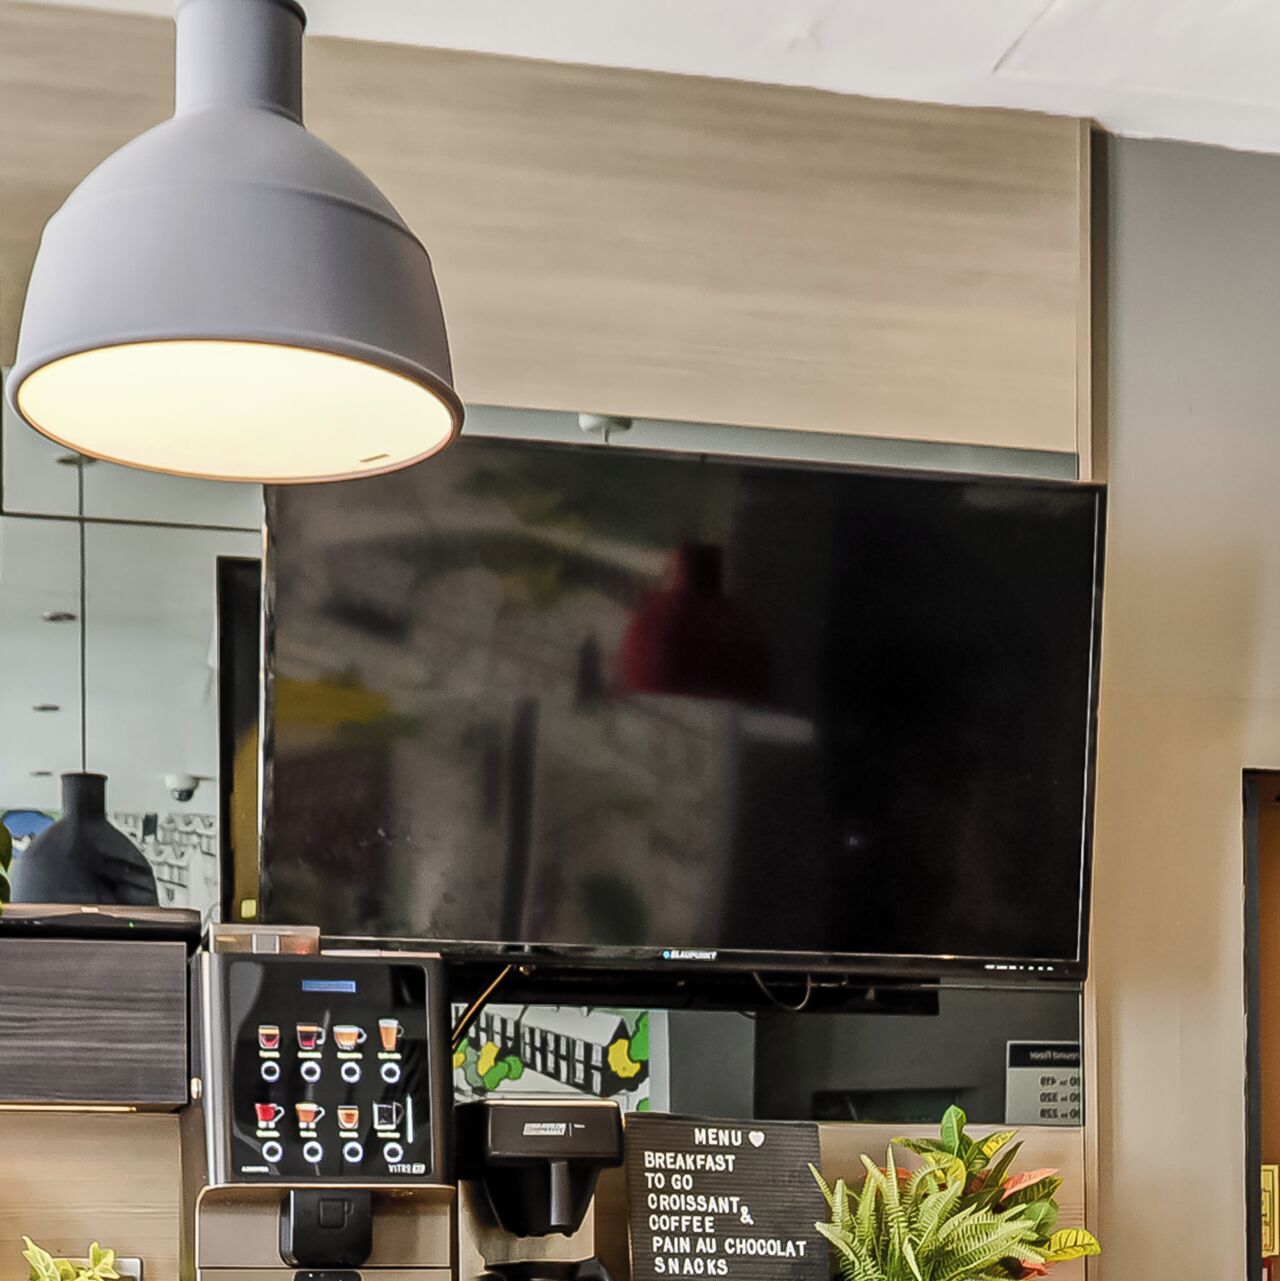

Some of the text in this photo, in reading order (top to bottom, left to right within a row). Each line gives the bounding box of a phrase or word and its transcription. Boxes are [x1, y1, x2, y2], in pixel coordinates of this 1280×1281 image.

[694, 1128, 742, 1147] MENU
[643, 1151, 736, 1172] BREAKFAST
[644, 1172, 694, 1191] TO GO
[647, 1193, 740, 1214] CROISSANT
[649, 1214, 715, 1233] COFFEE
[739, 1205, 754, 1225] &
[652, 1236, 807, 1258] PAIN AU CHOCOLAT
[654, 1257, 728, 1275] SNACKS
